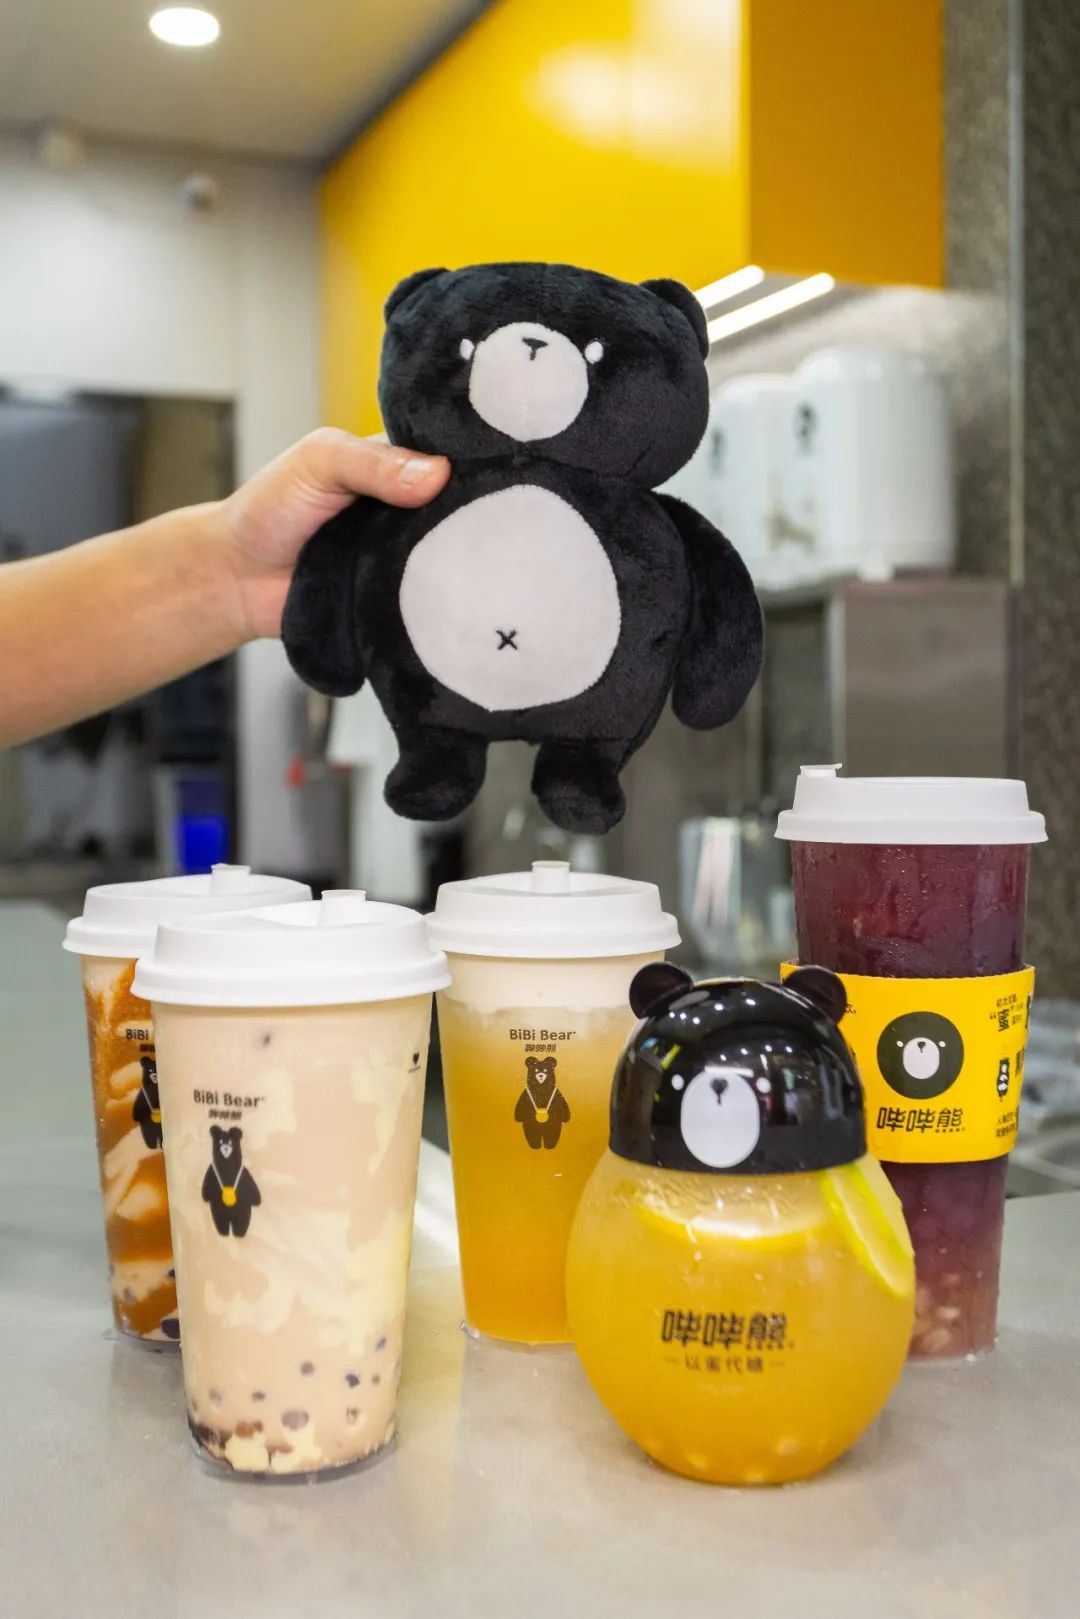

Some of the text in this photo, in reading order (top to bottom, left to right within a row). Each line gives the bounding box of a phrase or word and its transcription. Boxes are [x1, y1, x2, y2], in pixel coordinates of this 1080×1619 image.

[126, 1029, 149, 1040] BiBi
[509, 1029, 572, 1041] BiBi Bear
[193, 1089, 260, 1108] BiBi Bear
[876, 1106, 963, 1133] 哔哔熊
